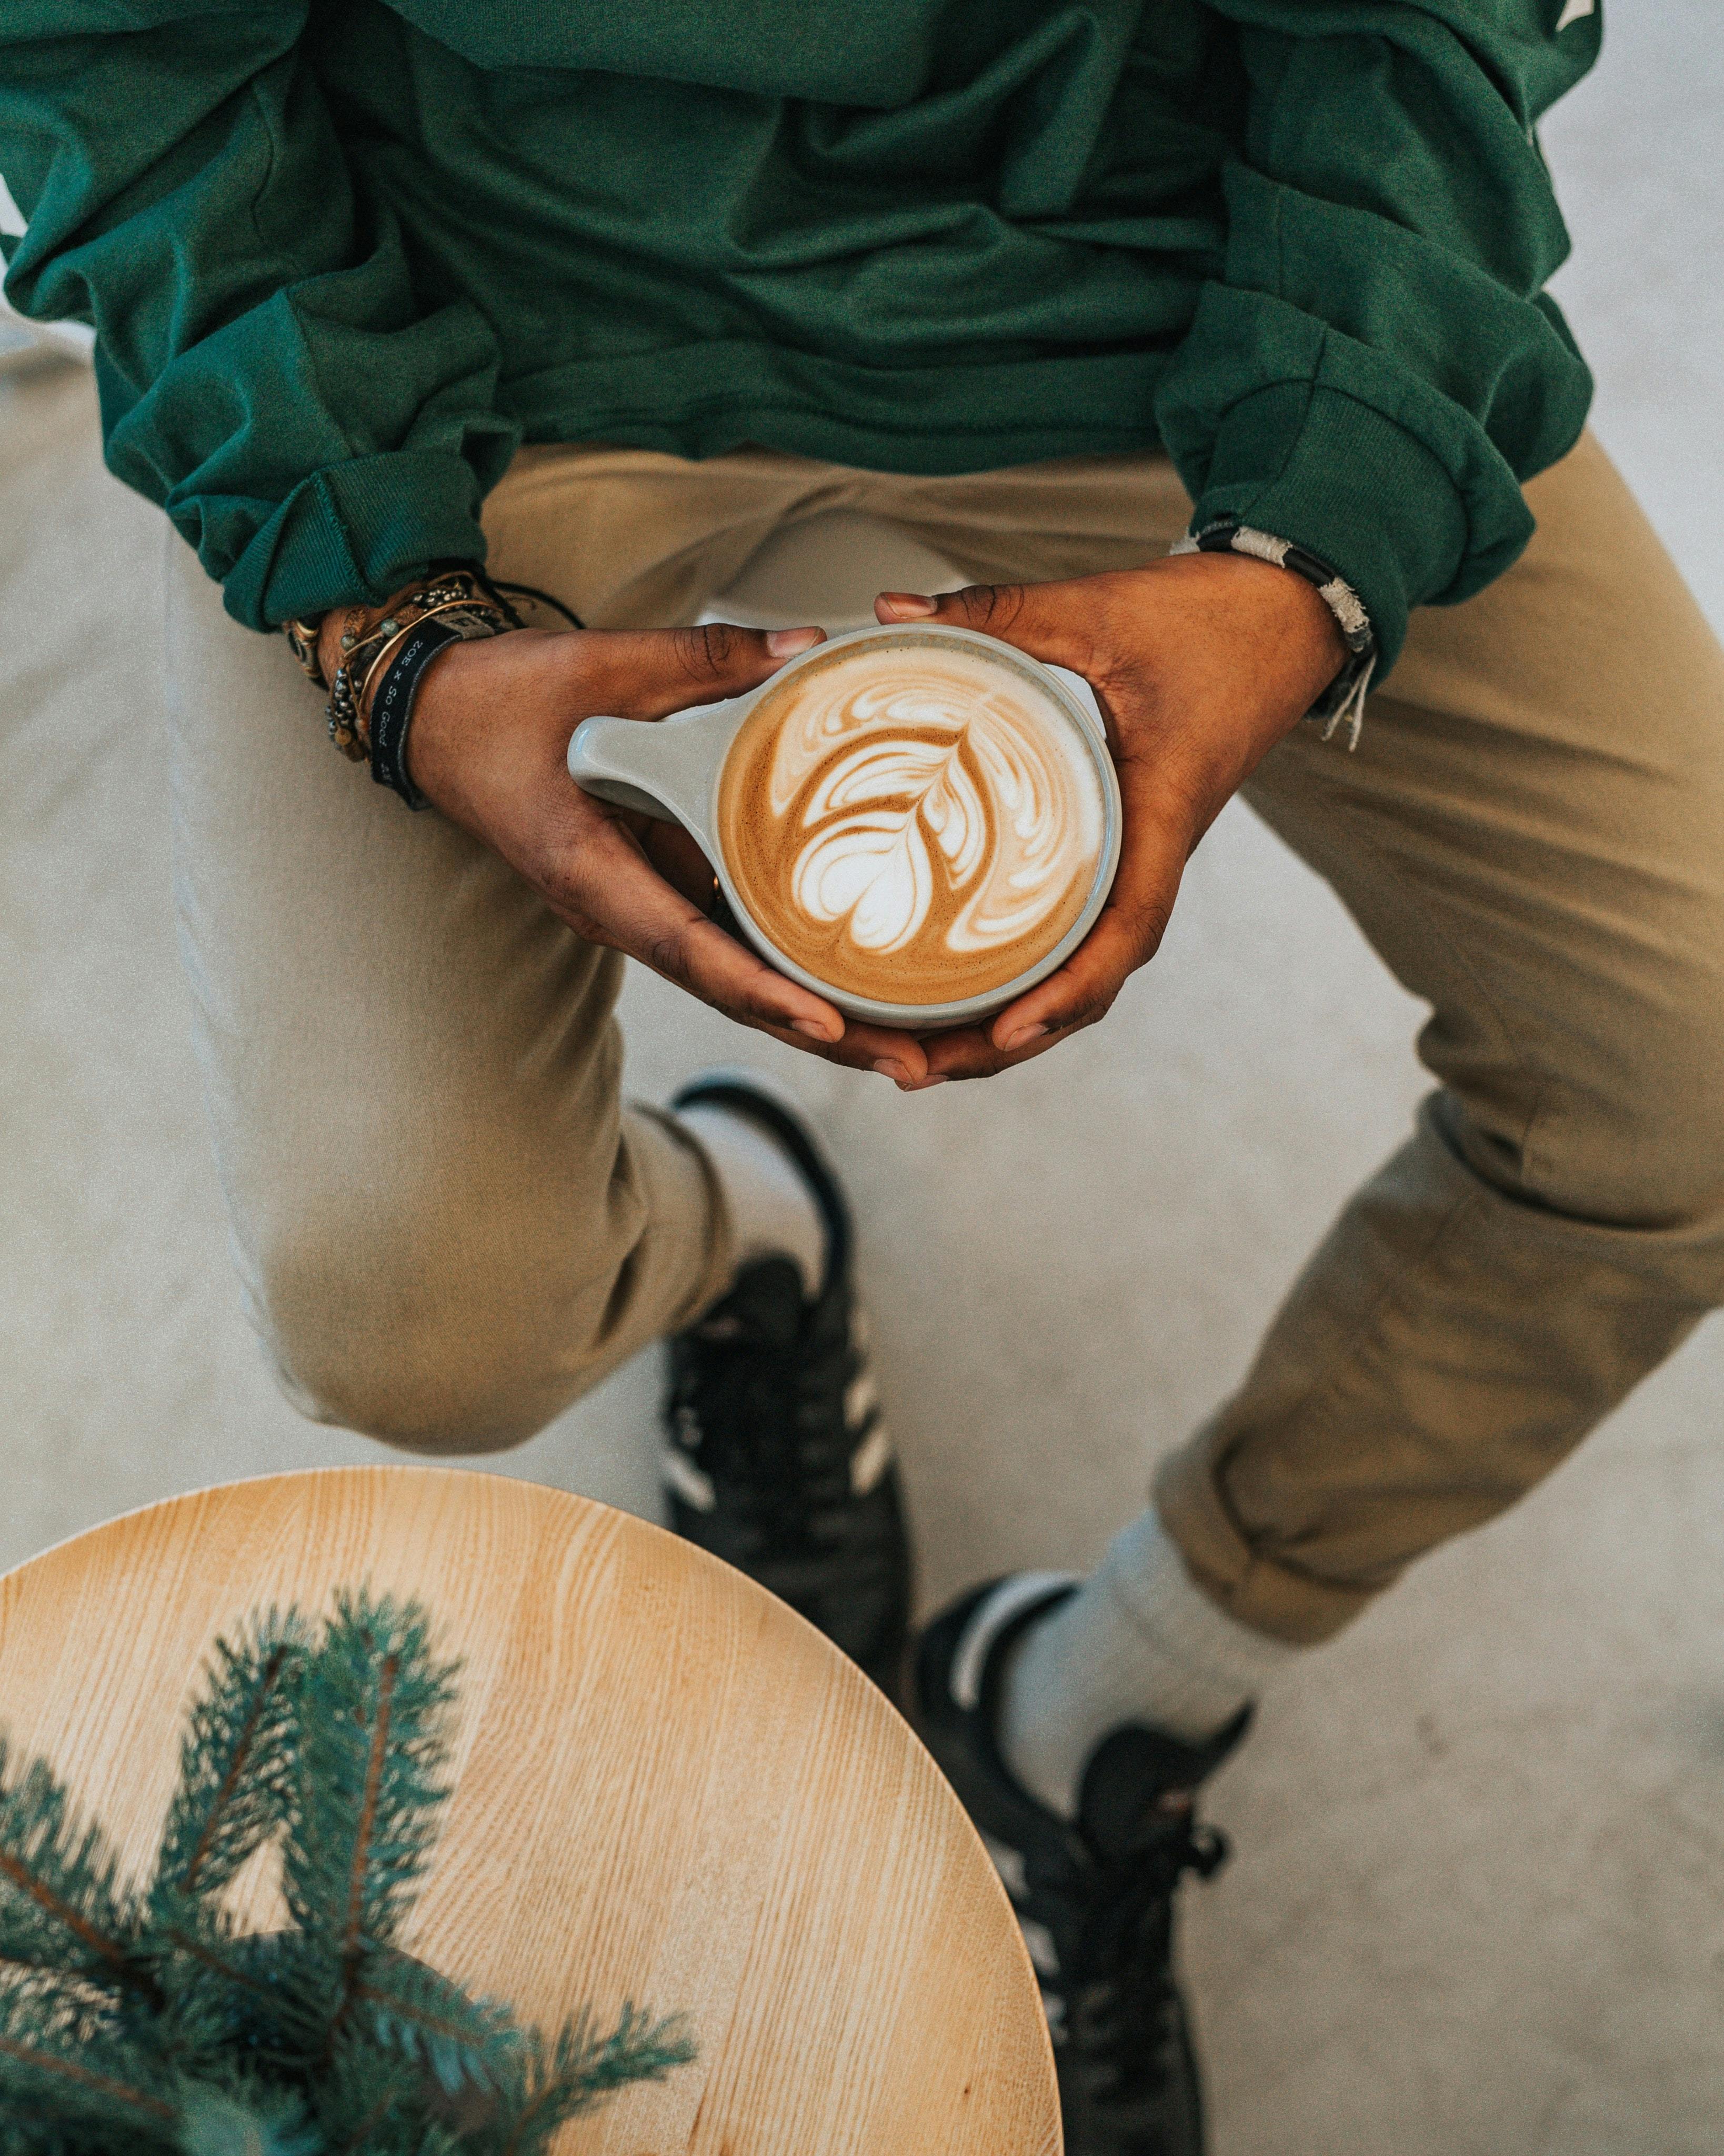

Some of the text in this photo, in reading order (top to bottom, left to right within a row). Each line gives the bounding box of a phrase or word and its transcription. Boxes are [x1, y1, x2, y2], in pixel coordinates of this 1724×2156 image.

[402, 641, 423, 666] ZOE
[386, 686, 397, 705] So
[379, 712, 390, 746] Good
